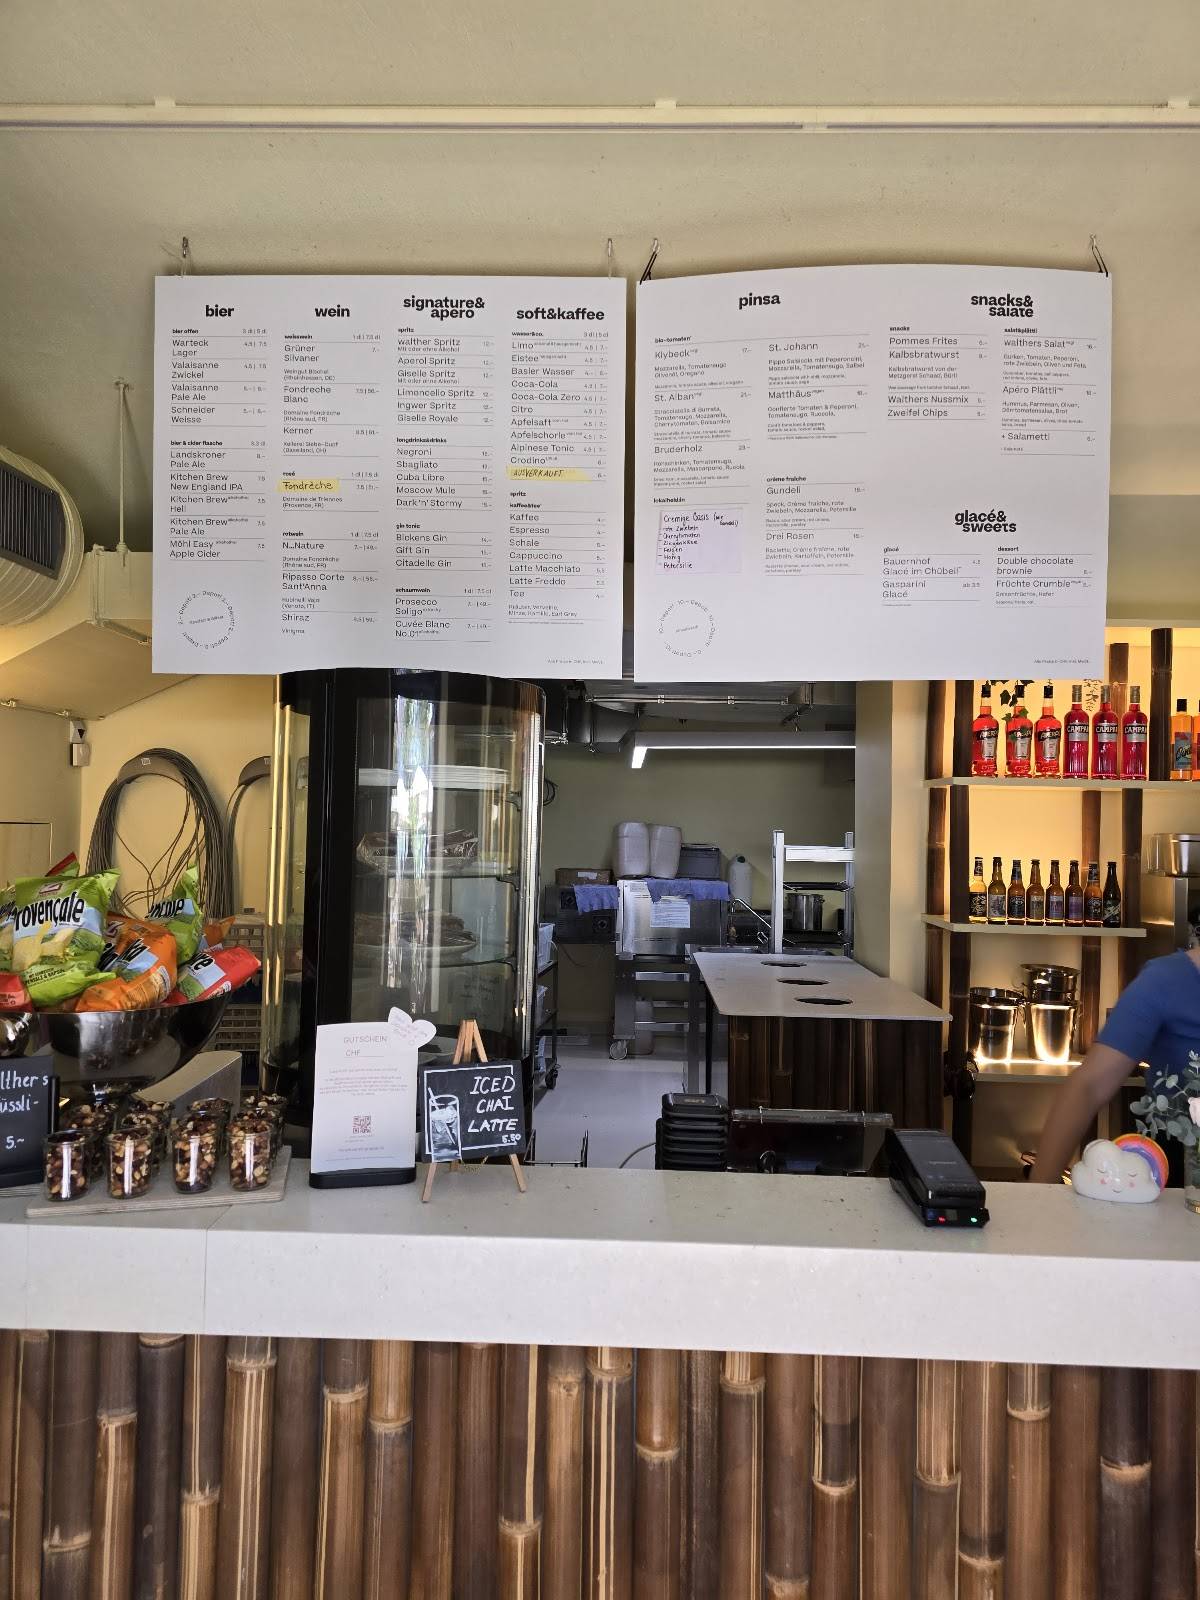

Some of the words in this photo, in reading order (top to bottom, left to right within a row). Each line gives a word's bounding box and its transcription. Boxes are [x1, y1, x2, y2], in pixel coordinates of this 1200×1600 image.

[403, 295, 485, 311] signature&
[739, 293, 781, 310] pinsa
[971, 294, 1033, 307] snacks&
[206, 304, 234, 317] bier
[315, 304, 350, 317] wein
[431, 308, 474, 321] apero
[517, 308, 604, 320] soft&kaffee
[989, 306, 1034, 318] salate
[434, 339, 460, 347] Spritz
[769, 344, 781, 352] St.
[784, 342, 818, 351] Johann
[890, 351, 959, 359] Kalbsbratwurst
[398, 357, 426, 366] Aperol
[429, 358, 455, 366] Spritz
[397, 370, 426, 378] Giselle
[429, 370, 455, 379] Spritz
[397, 389, 445, 397] Limoncello
[448, 390, 474, 398] Spritz
[1003, 386, 1028, 395] Apéro
[654, 394, 666, 402] St.
[397, 402, 426, 411] Ingwer
[430, 403, 456, 411] Spritz
[923, 409, 948, 418] Chips
[397, 415, 427, 423] Giselle
[429, 415, 458, 424] Royale
[1008, 433, 1050, 441] Salametti
[397, 448, 431, 457] Negroni
[511, 444, 548, 453] Alpinese
[655, 445, 702, 454] Bruderholz
[397, 461, 438, 470] Sbagliato
[170, 473, 203, 481] Kitchen
[423, 474, 444, 482] Libre
[191, 484, 226, 492] England
[955, 509, 1006, 525] glacé&
[510, 527, 549, 535] Espresso
[963, 523, 1016, 532] sweets
[510, 539, 539, 547] Schale
[170, 550, 193, 559] Apple
[510, 552, 562, 561] Cappuccino
[536, 565, 580, 573] Macchiato
[283, 574, 317, 583] Ripasso
[282, 583, 327, 591] Sant'Anna
[883, 581, 926, 589] Gasparini
[882, 590, 908, 598] Glacé
[344, 1036, 388, 1044] GUTSCHEIN
[470, 1076, 515, 1094] ICED
[477, 1096, 514, 1113] CHAI
[468, 1119, 518, 1132] LATTE
